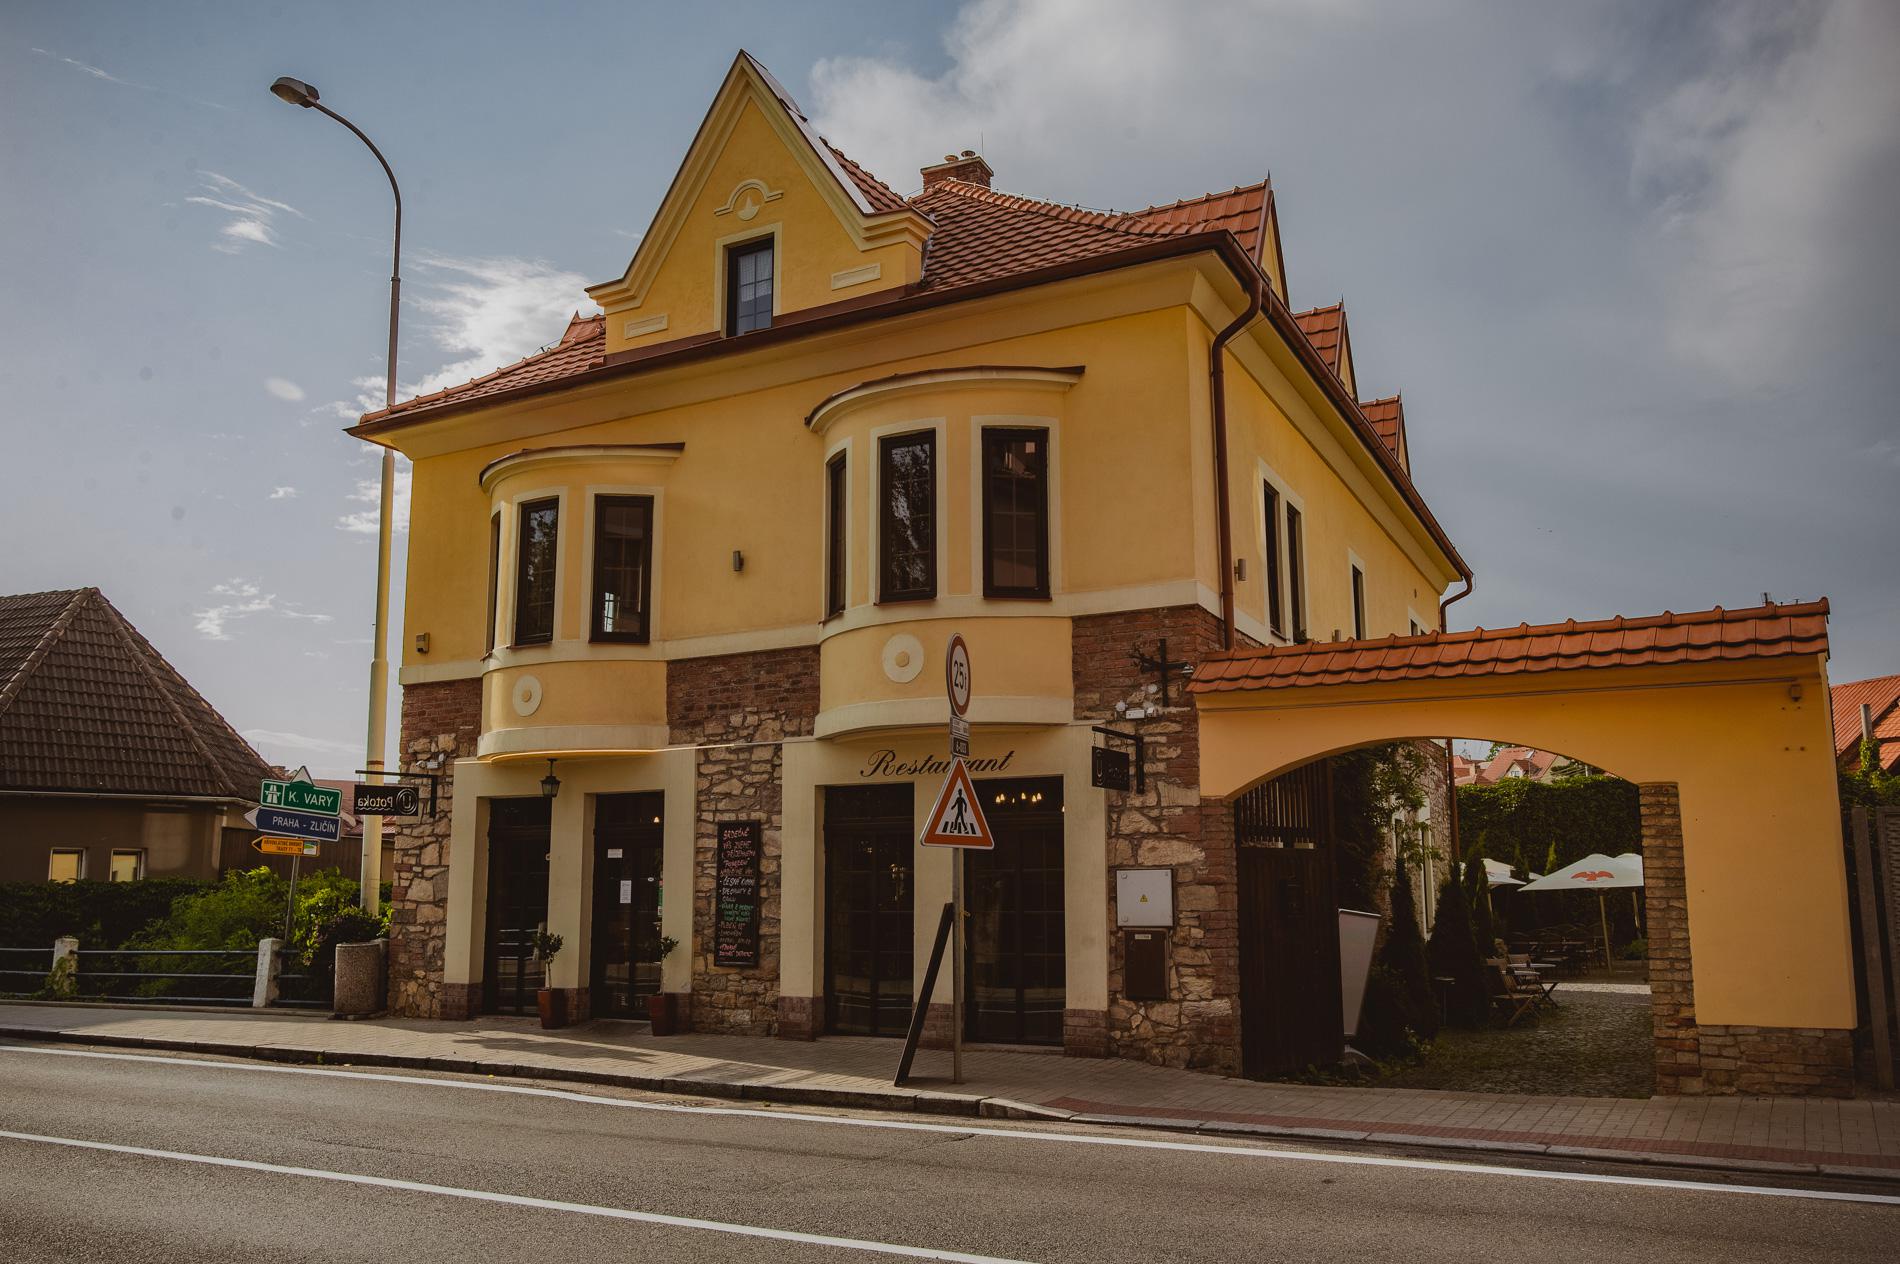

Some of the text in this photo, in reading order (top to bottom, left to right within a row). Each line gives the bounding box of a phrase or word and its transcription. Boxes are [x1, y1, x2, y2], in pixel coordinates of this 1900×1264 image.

[860, 749, 1015, 778] Restaant
[288, 791, 333, 807] K. VARY
[272, 816, 300, 829] PRAHA
[310, 820, 336, 833] ZLIČÍN
